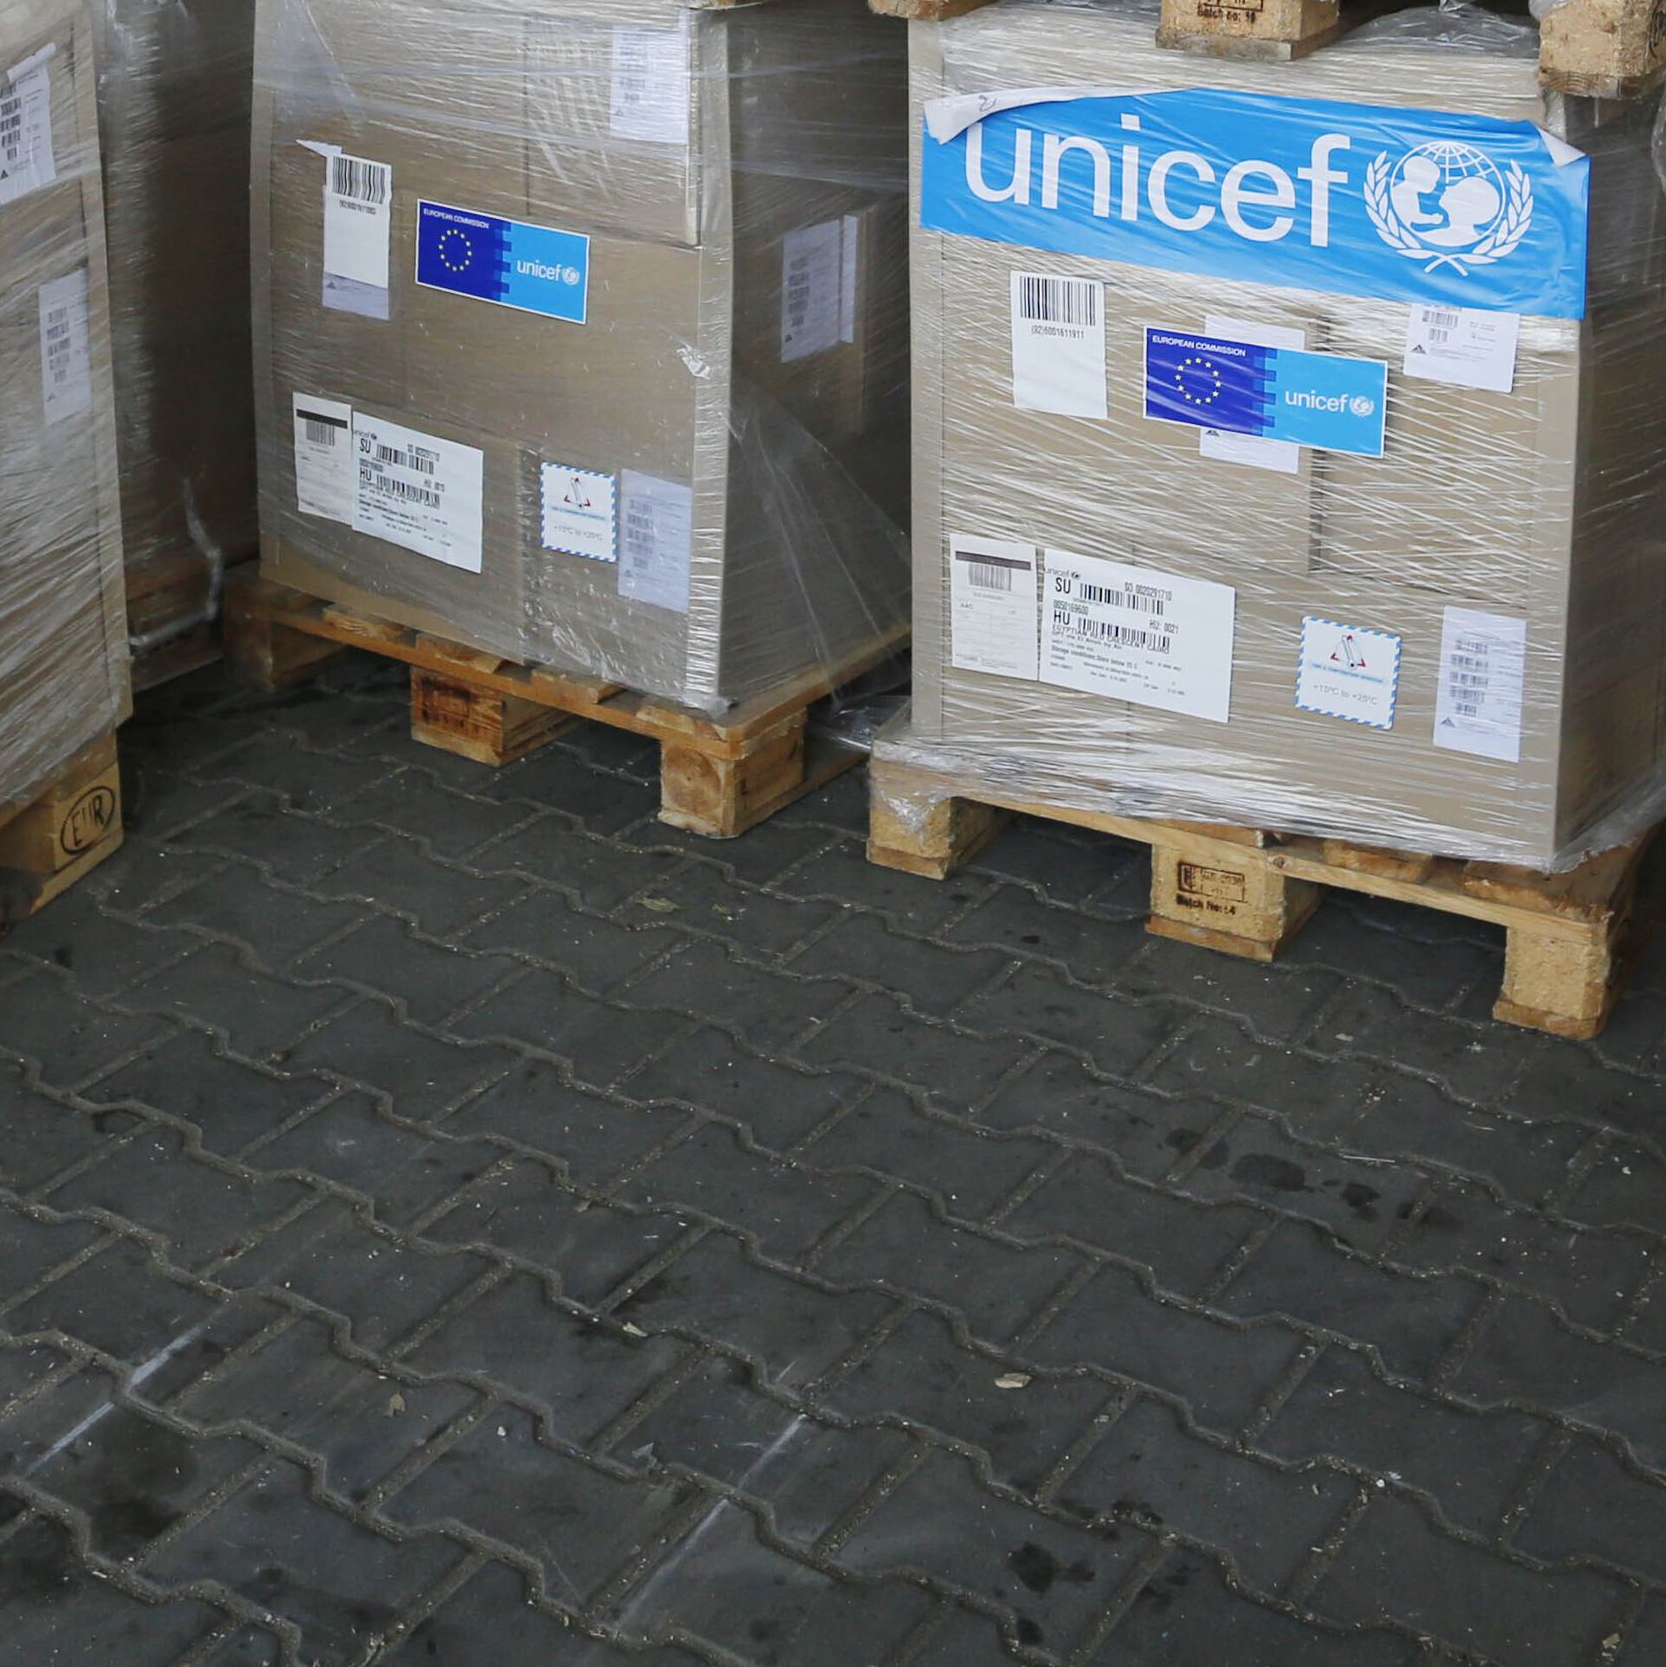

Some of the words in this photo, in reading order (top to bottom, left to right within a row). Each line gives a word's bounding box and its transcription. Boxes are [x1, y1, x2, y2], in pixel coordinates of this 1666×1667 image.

[966, 113, 1351, 247] unicef
[424, 208, 453, 222] EUROPEAN
[454, 215, 489, 230] COMMISSION
[517, 260, 562, 281] unicef
[1152, 336, 1194, 349] EUROPEAN
[1196, 342, 1246, 357] COMMISSION
[1285, 390, 1349, 413] unicef
[360, 438, 371, 453] SU
[359, 467, 372, 481] HU
[1055, 577, 1071, 594] SU
[1053, 610, 1070, 625] HU
